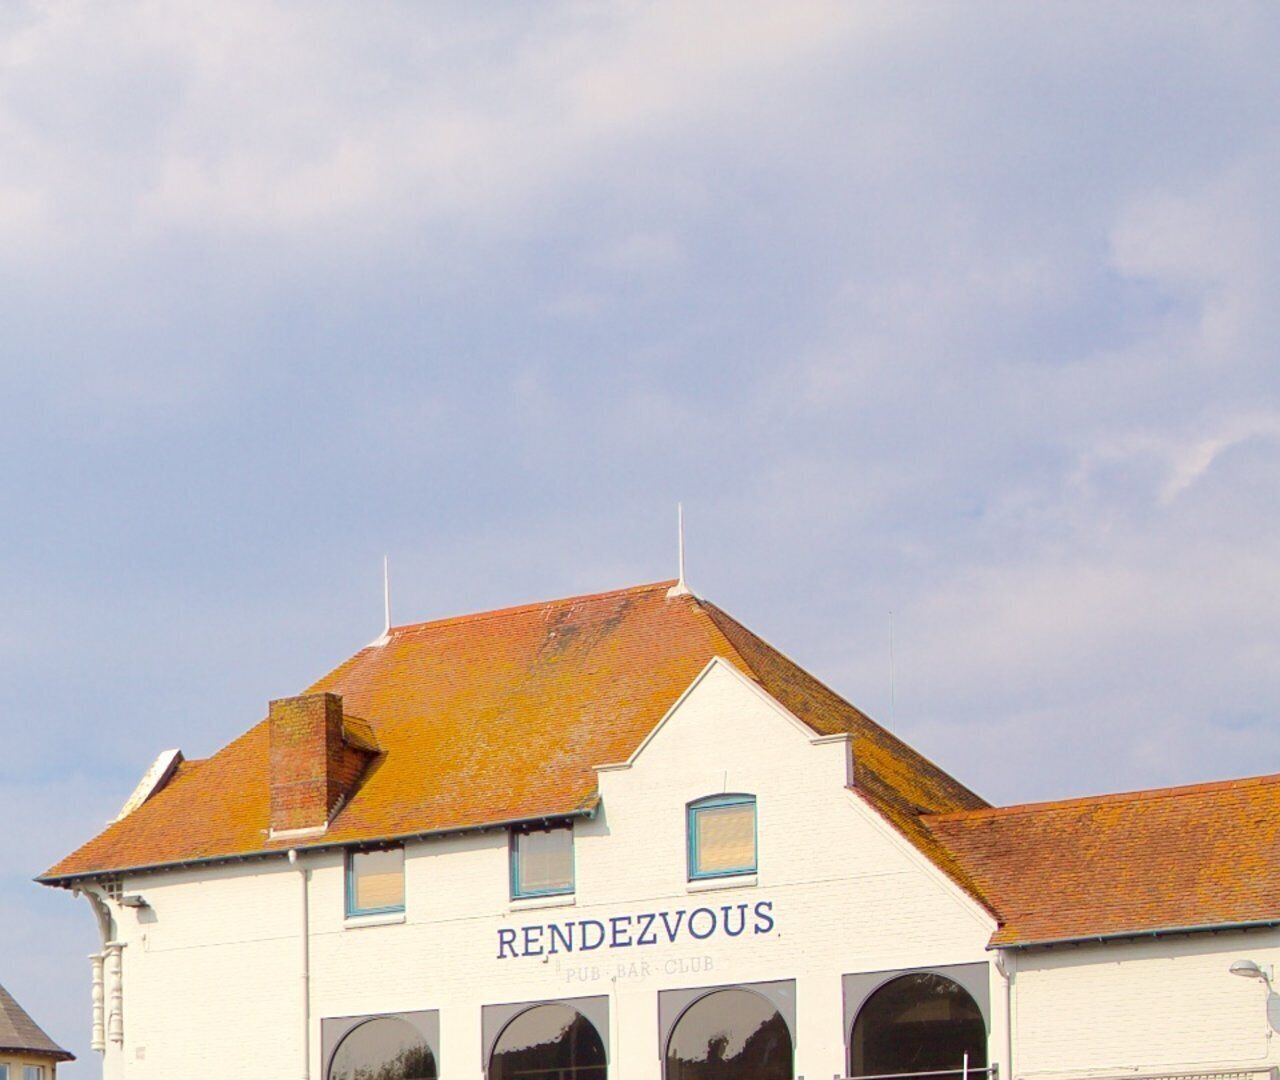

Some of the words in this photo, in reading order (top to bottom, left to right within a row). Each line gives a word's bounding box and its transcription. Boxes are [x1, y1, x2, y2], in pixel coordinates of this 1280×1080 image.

[495, 900, 775, 960] RENDEZVOUS
[565, 967, 601, 984] PUB
[616, 962, 650, 980] BAR
[664, 956, 715, 975] CLUB
